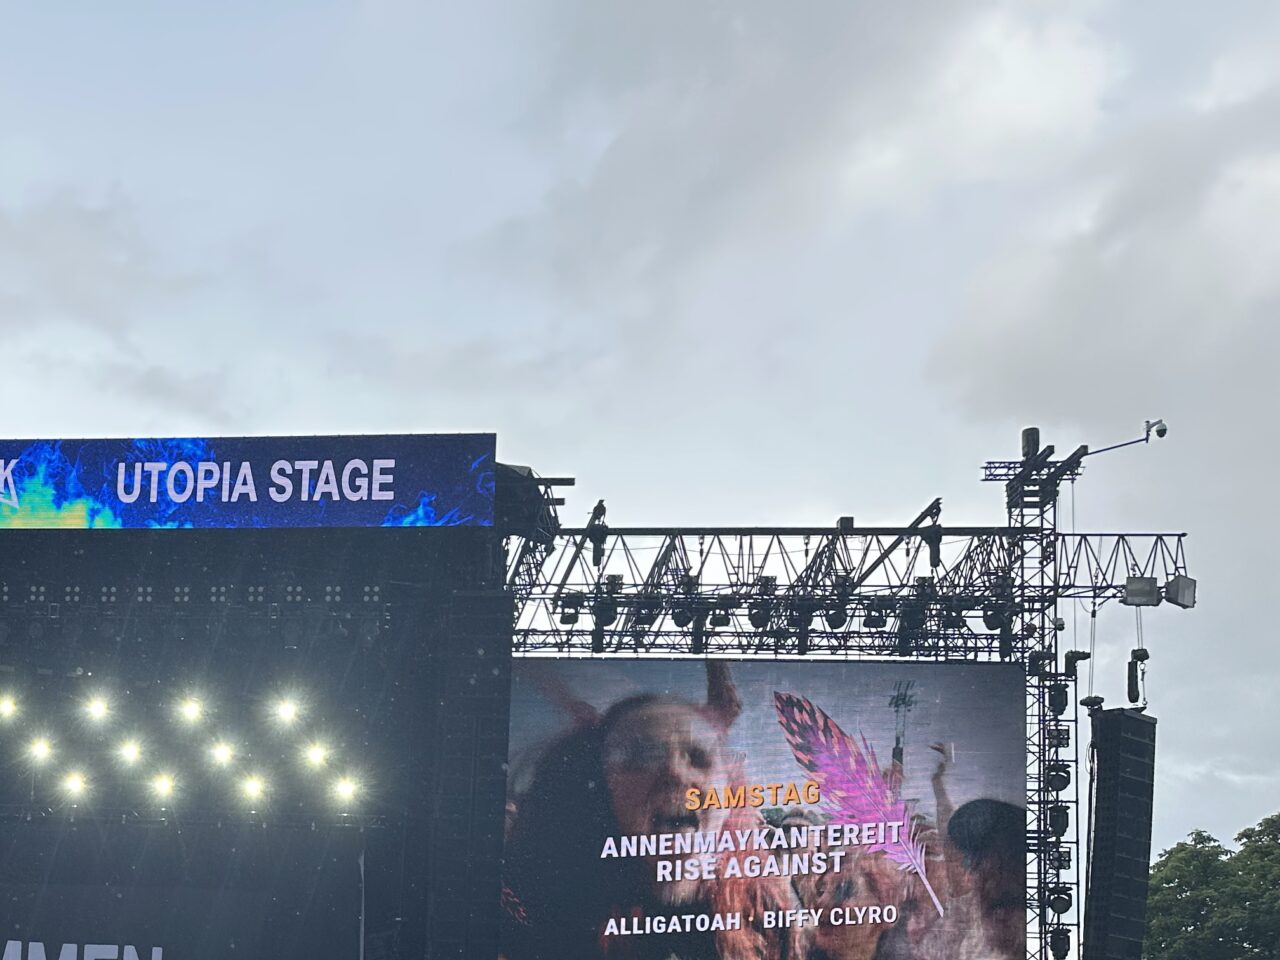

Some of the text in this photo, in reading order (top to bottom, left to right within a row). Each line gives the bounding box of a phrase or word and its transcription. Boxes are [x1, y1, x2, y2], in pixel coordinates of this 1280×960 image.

[117, 459, 396, 503] UTOPIA STAGE
[685, 780, 820, 811] SAMSTAG
[600, 821, 904, 858] ANNENMAYKANTEREIT
[656, 851, 846, 882] RISE AGAINST
[604, 905, 898, 936] ALLIGATOAH BIFFY CLYRO
